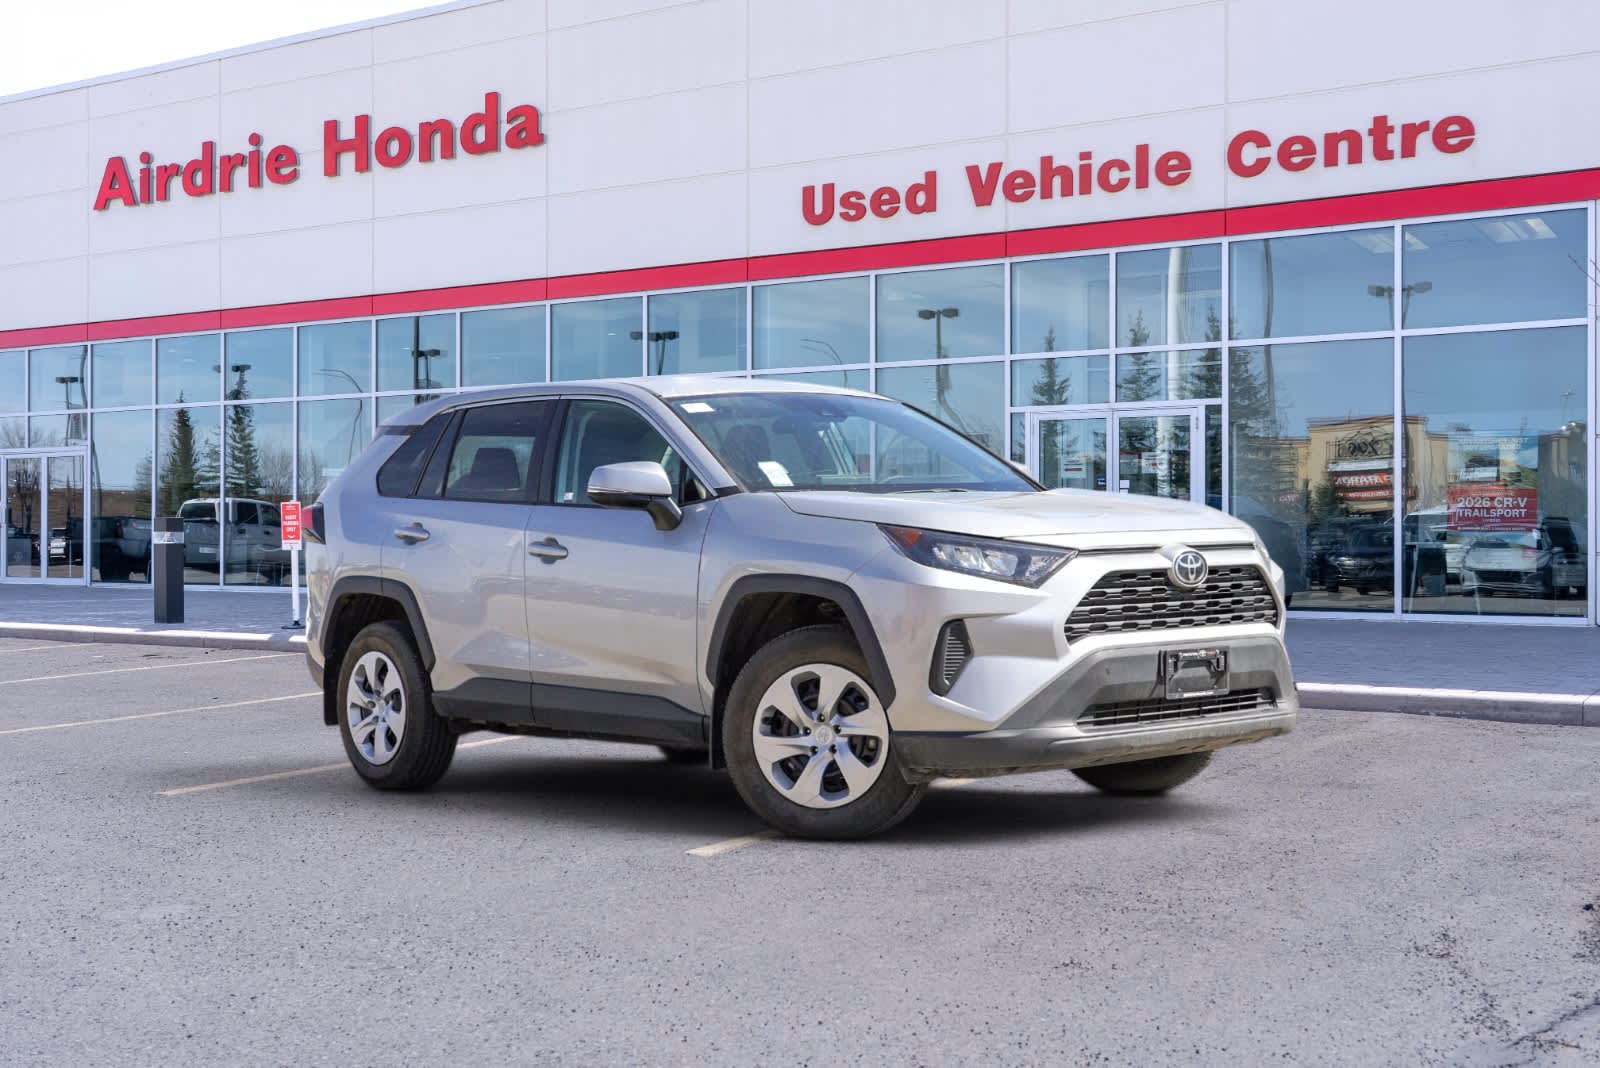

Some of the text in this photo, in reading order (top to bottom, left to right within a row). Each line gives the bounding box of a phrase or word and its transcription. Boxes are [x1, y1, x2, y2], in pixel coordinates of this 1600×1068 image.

[94, 92, 546, 211] Airdrie Honda
[802, 115, 1476, 225] Used Vehicle Centre
[1457, 497, 1527, 508] 2026 CR-V
[1458, 508, 1527, 518] TRAILSPORT
